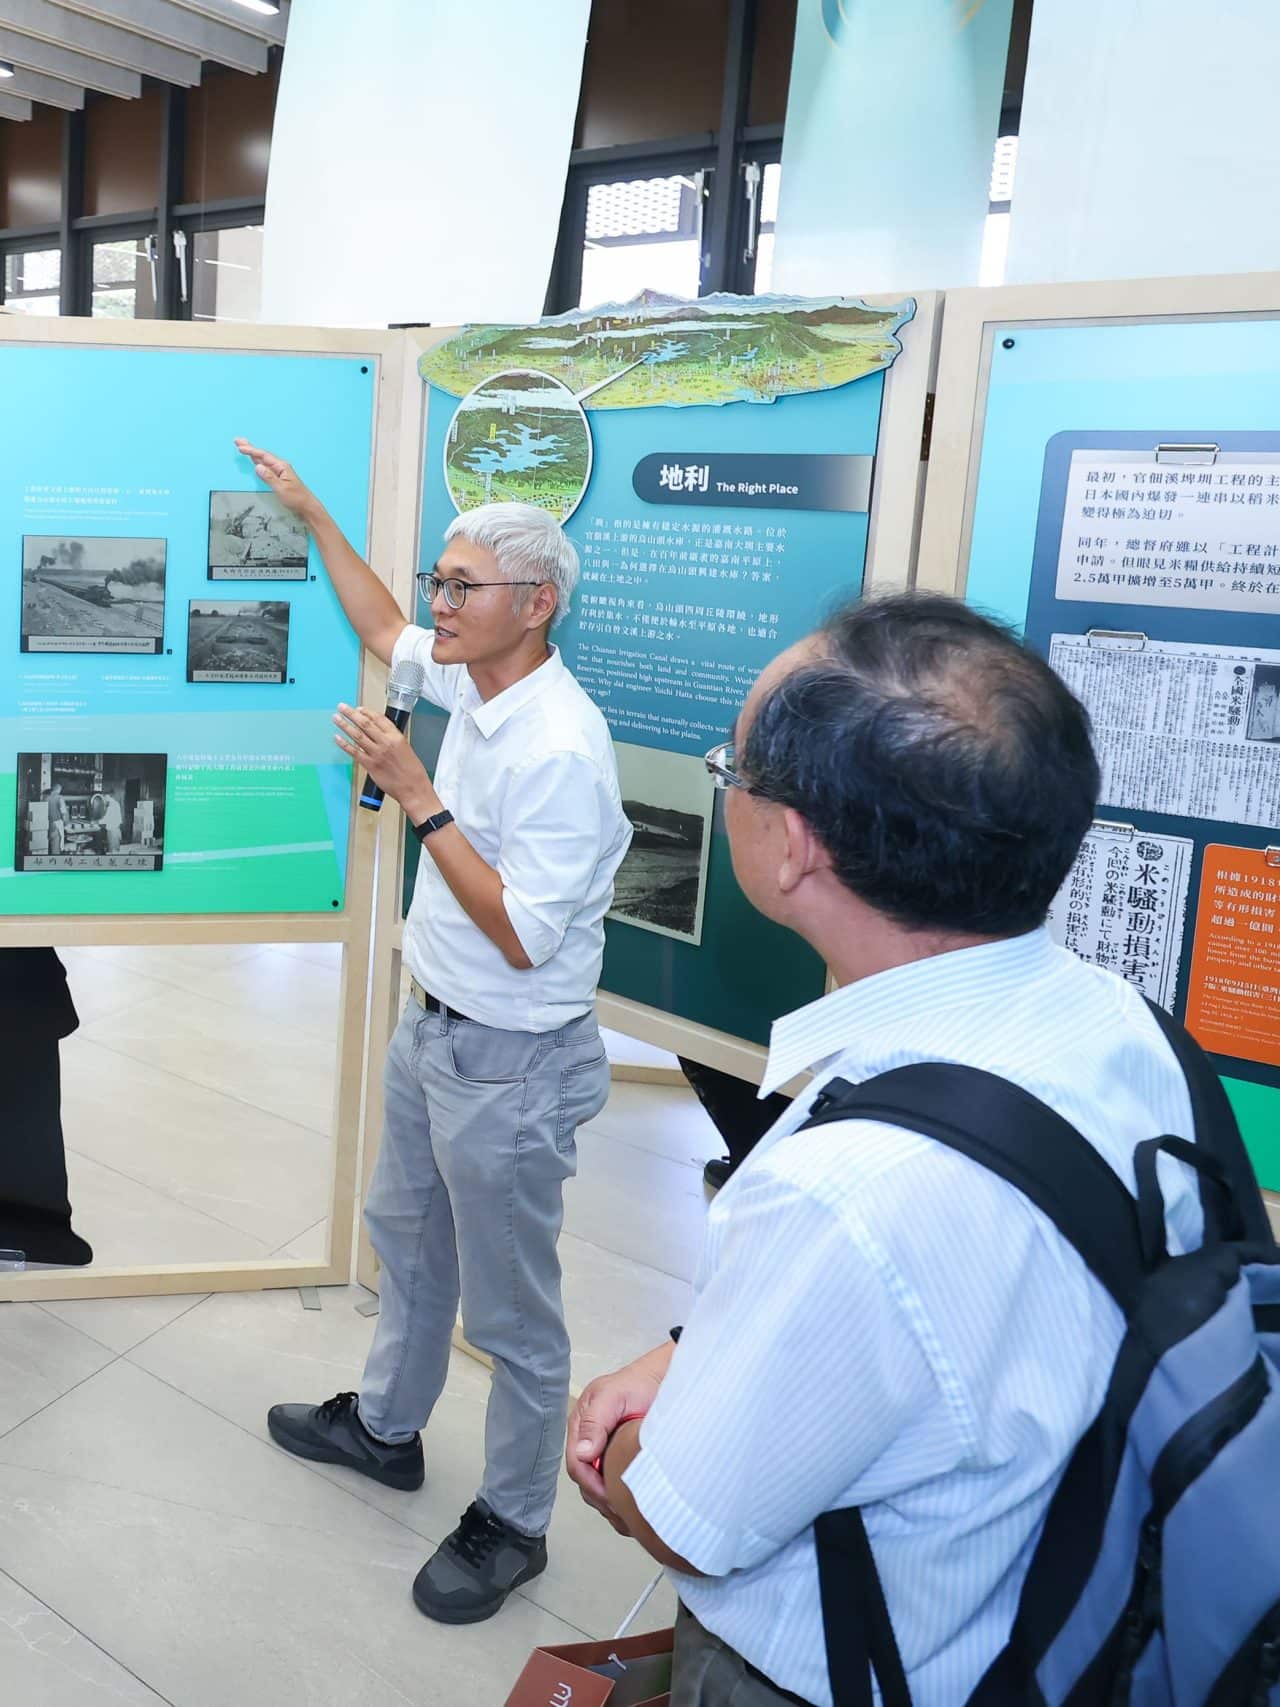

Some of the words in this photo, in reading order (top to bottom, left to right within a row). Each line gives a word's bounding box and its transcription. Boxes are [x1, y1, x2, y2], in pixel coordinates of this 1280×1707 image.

[659, 464, 710, 492] 地利
[716, 482, 736, 493] The
[738, 482, 766, 495] Right
[769, 484, 799, 495] Place
[578, 643, 589, 651] The
[649, 652, 668, 663] Canal
[670, 656, 689, 665] draws
[700, 659, 715, 668] vital
[738, 664, 746, 672] of
[592, 656, 604, 664] that
[639, 662, 654, 672] both
[657, 664, 671, 674] land
[674, 666, 688, 676] and
[638, 672, 653, 684] high
[1216, 869, 1280, 887] 根據1918
[1214, 885, 1280, 903] 所造成的財
